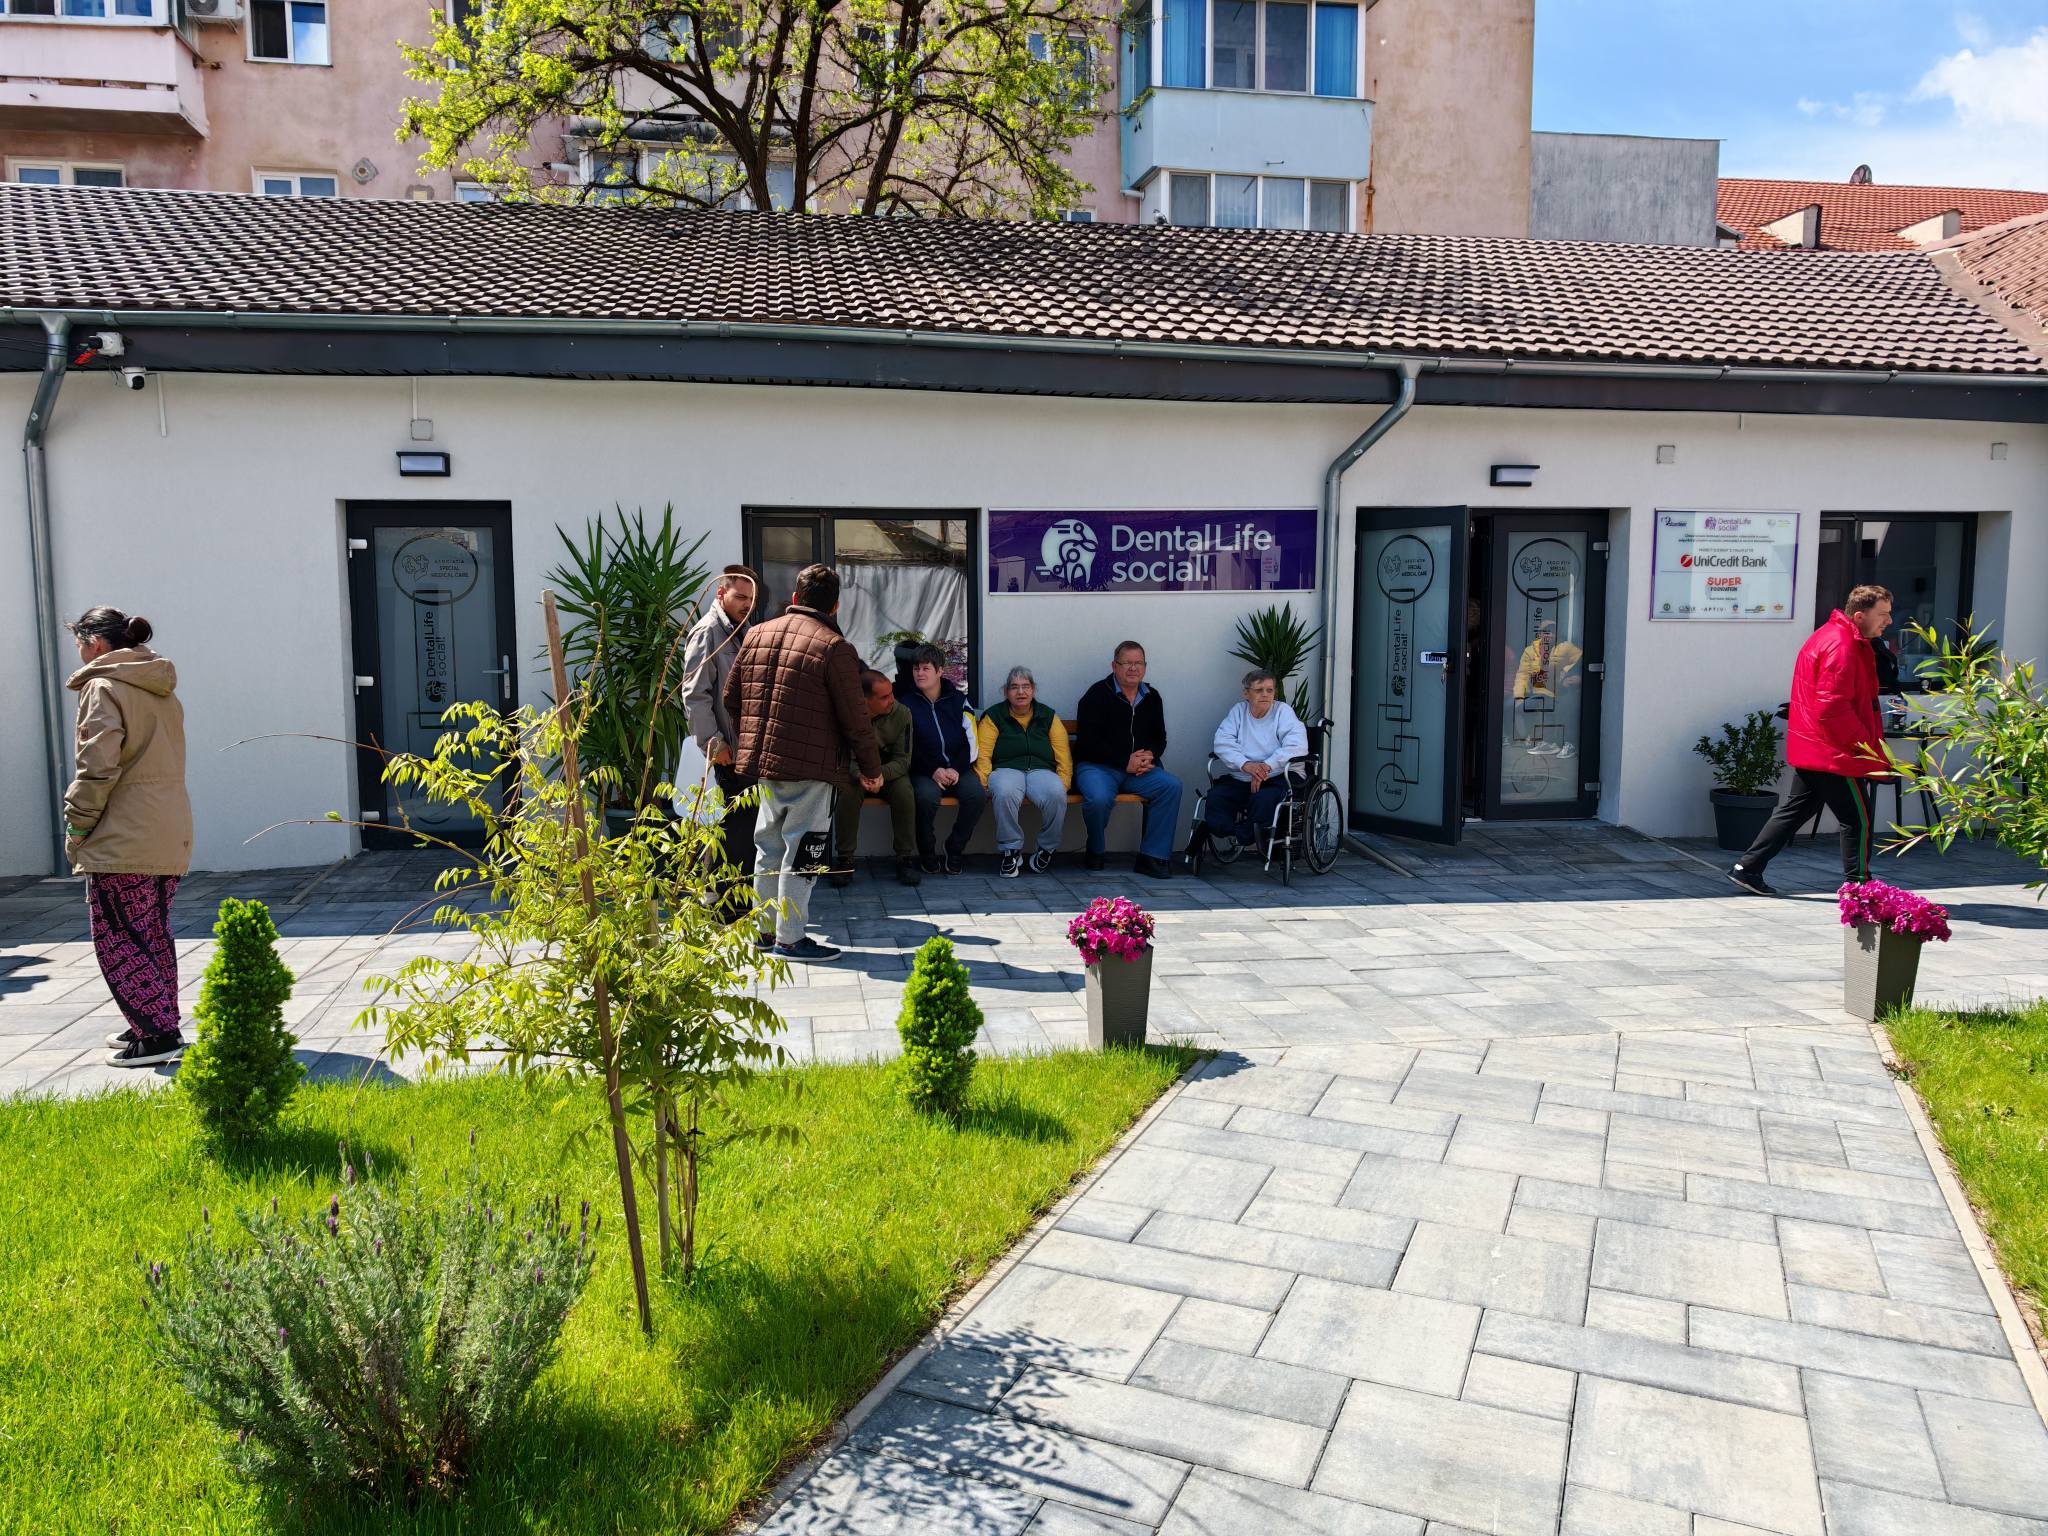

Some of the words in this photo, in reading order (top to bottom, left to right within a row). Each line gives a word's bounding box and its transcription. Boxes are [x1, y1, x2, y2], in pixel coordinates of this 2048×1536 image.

[1111, 555, 1209, 582] social!
[1693, 555, 1740, 568] UniCredit
[1741, 555, 1768, 569] Bank
[1707, 576, 1742, 586] SUPER
[435, 636, 447, 677] social!
